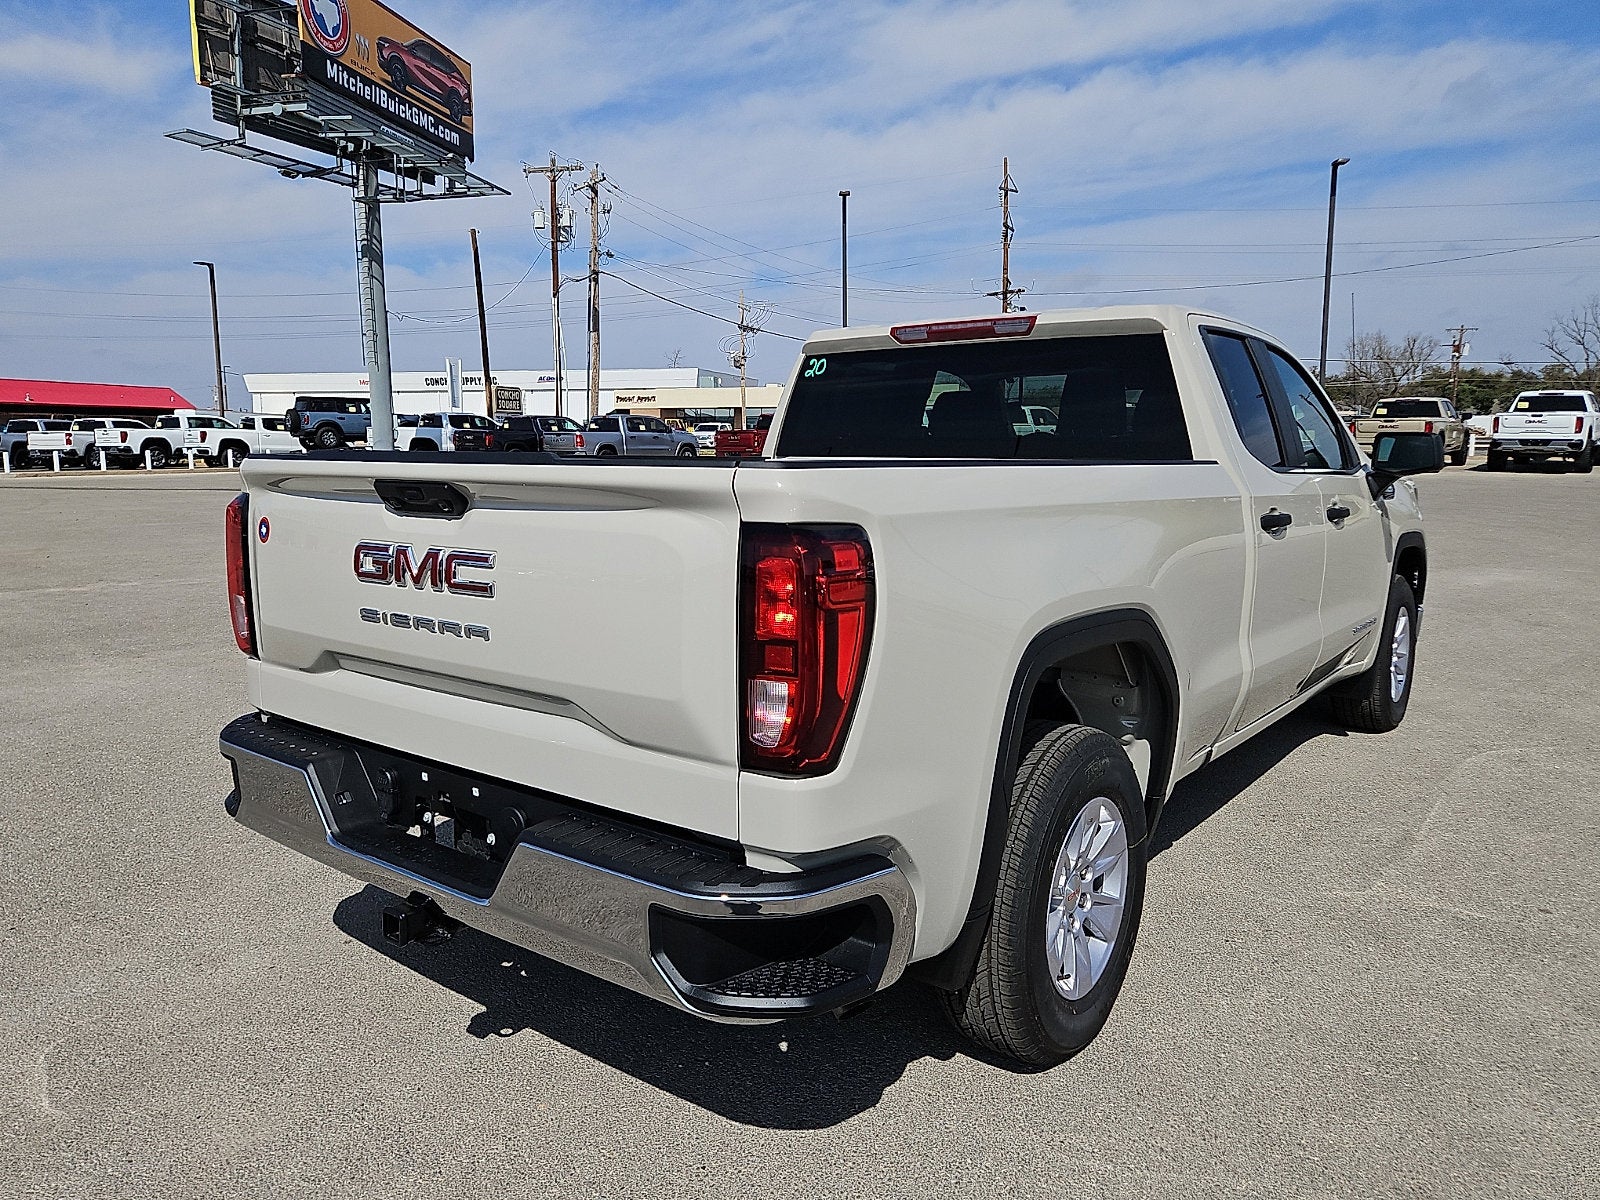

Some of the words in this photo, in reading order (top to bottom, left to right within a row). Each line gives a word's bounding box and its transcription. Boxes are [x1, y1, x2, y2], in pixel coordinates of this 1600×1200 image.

[350, 59, 377, 77] BUICK
[326, 59, 461, 147] MitchellBuickGMC.com
[804, 358, 827, 378] 20
[497, 390, 520, 401] CONCHO
[498, 400, 520, 410] SQUARE
[353, 539, 498, 599] GMC
[359, 607, 492, 642] SIERRA
